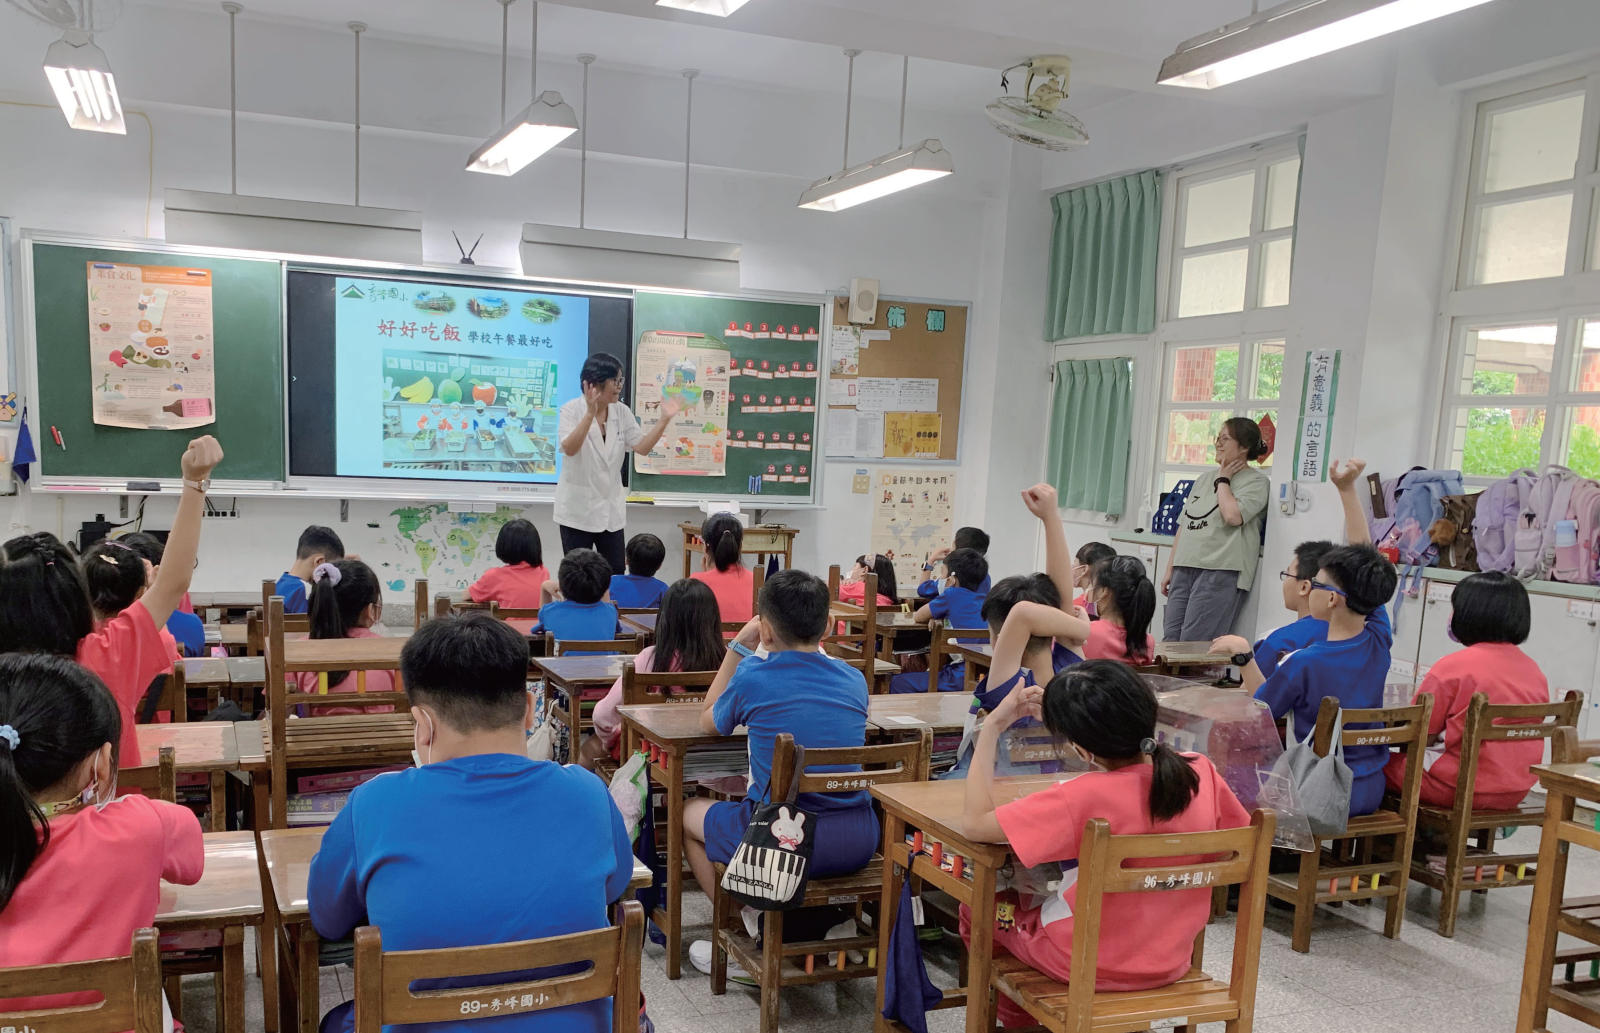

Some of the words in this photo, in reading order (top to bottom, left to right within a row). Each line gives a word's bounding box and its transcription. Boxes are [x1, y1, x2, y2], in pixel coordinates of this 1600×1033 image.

[97, 268, 137, 281] 米食文化
[376, 318, 462, 342] 好好吃飯
[467, 330, 554, 349] 學校午餐最好吃
[1303, 355, 1329, 477] 有意義的言語
[1187, 520, 1208, 531] Smile
[826, 779, 876, 789] 89-秀峰國小
[1144, 870, 1215, 889] 96-秀峰國小
[459, 993, 549, 1014] 89-秀峰國小
